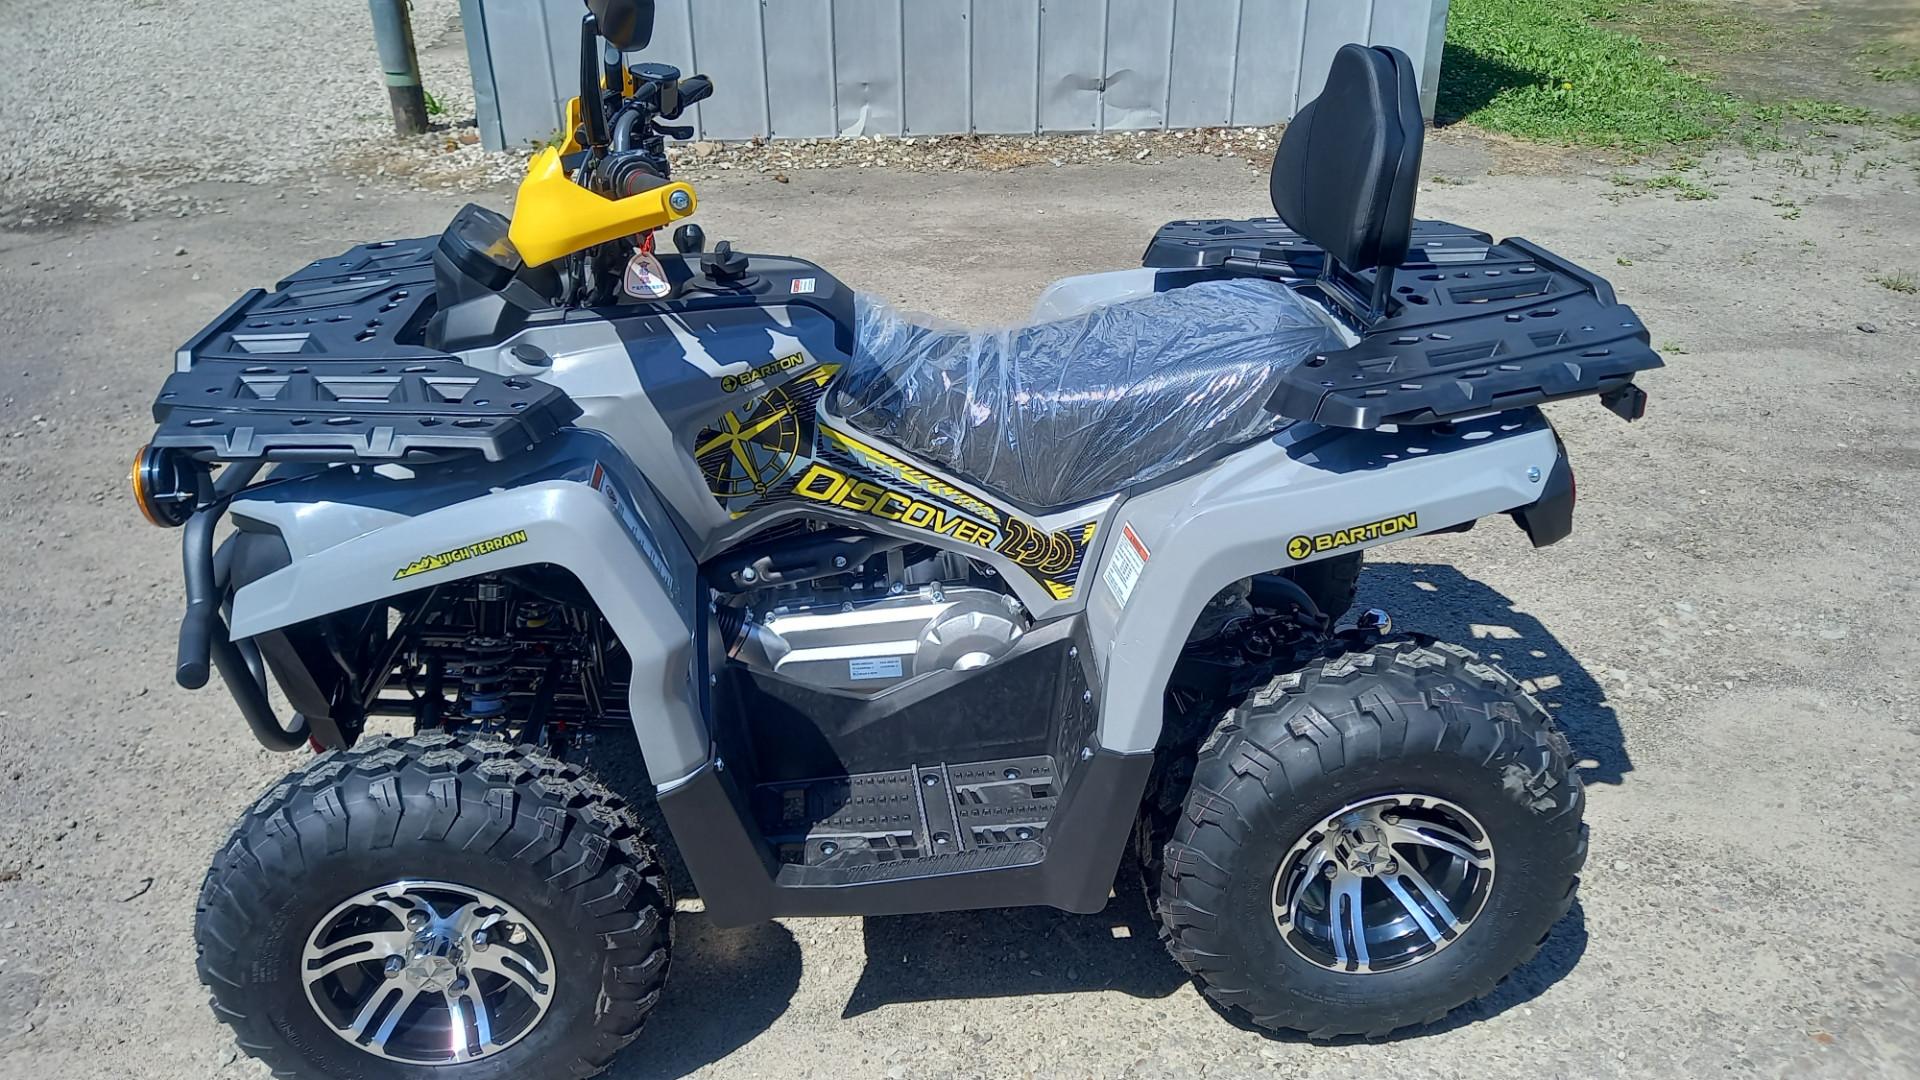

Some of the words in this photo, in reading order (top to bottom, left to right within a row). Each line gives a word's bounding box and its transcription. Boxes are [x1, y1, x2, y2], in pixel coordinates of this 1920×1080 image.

[739, 352, 804, 386] BARTON
[792, 464, 996, 549] DISCOVER
[438, 547, 471, 566] HIGH
[470, 530, 527, 556] TERRAIN
[1314, 511, 1417, 552] BARTON
